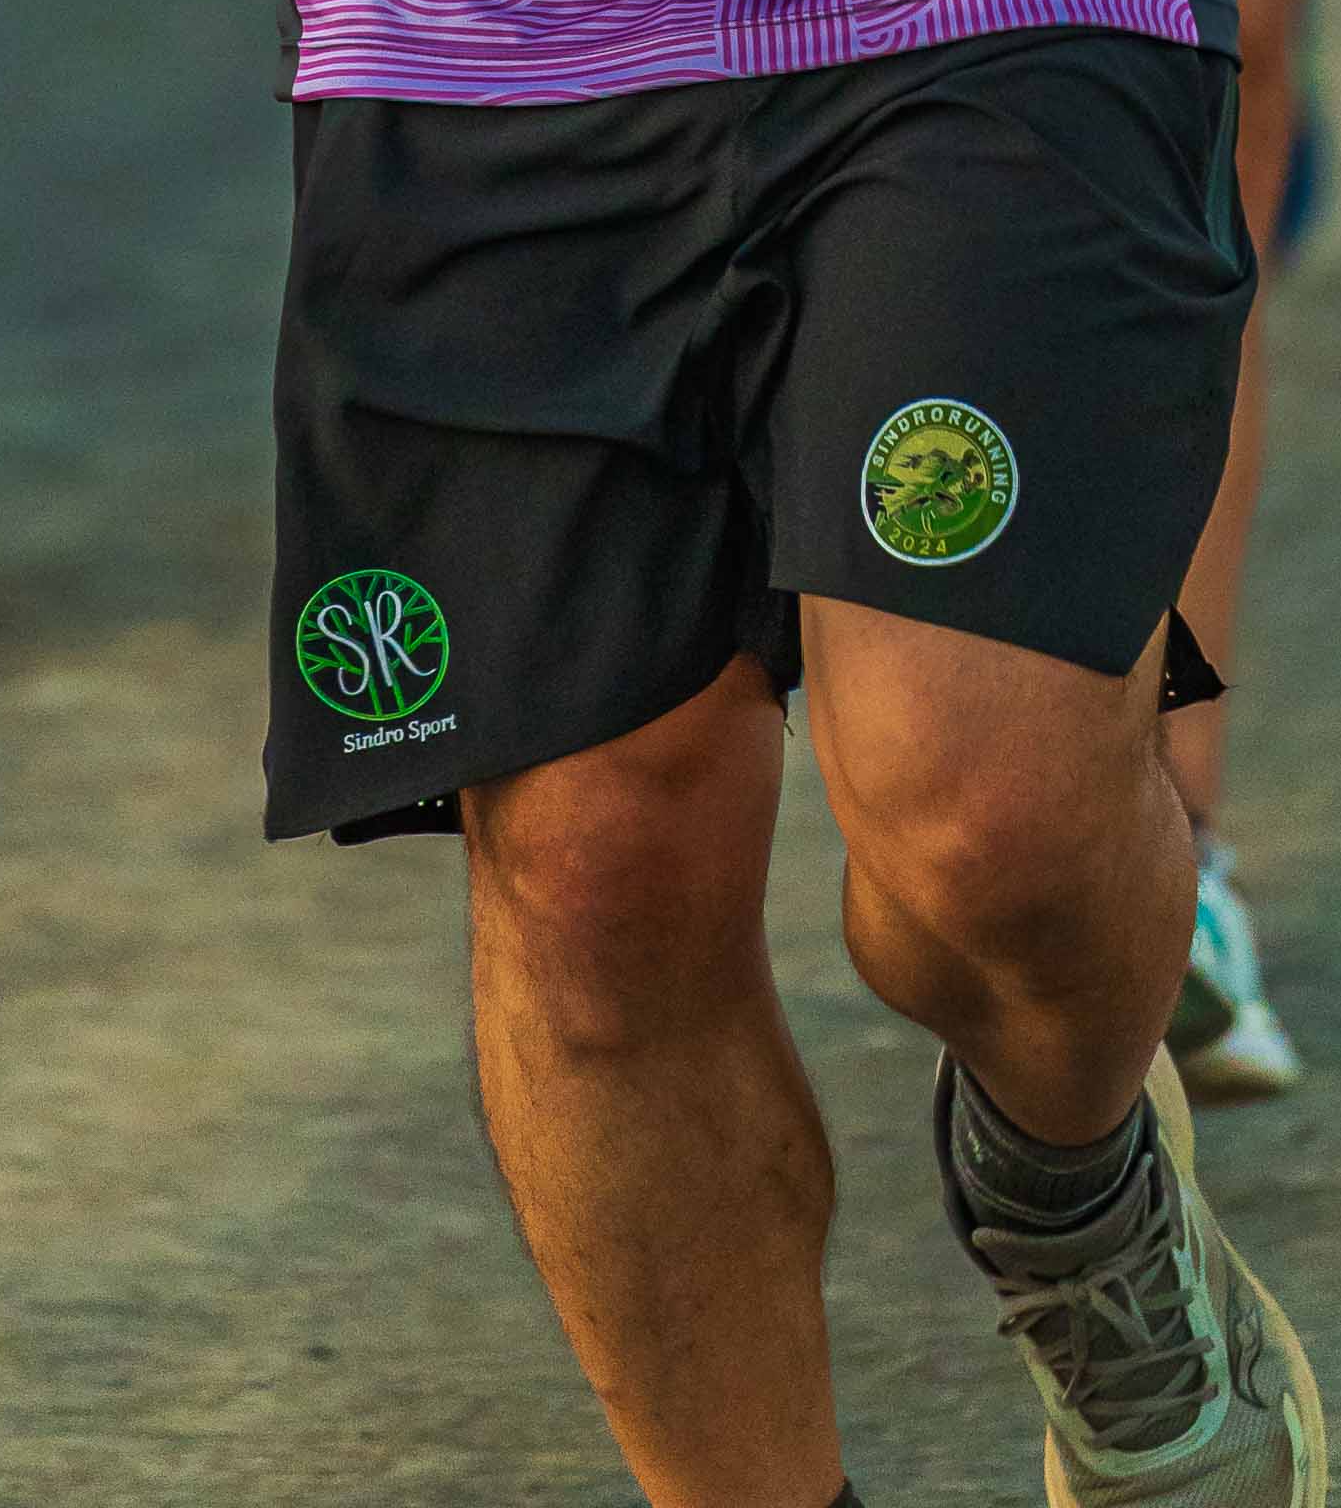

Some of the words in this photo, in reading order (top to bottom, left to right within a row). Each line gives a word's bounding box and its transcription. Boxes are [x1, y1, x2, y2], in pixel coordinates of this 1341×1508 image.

[889, 527, 947, 555] 2024
[317, 590, 437, 696] SR
[343, 727, 404, 753] Sindro
[408, 714, 457, 742] Sport
